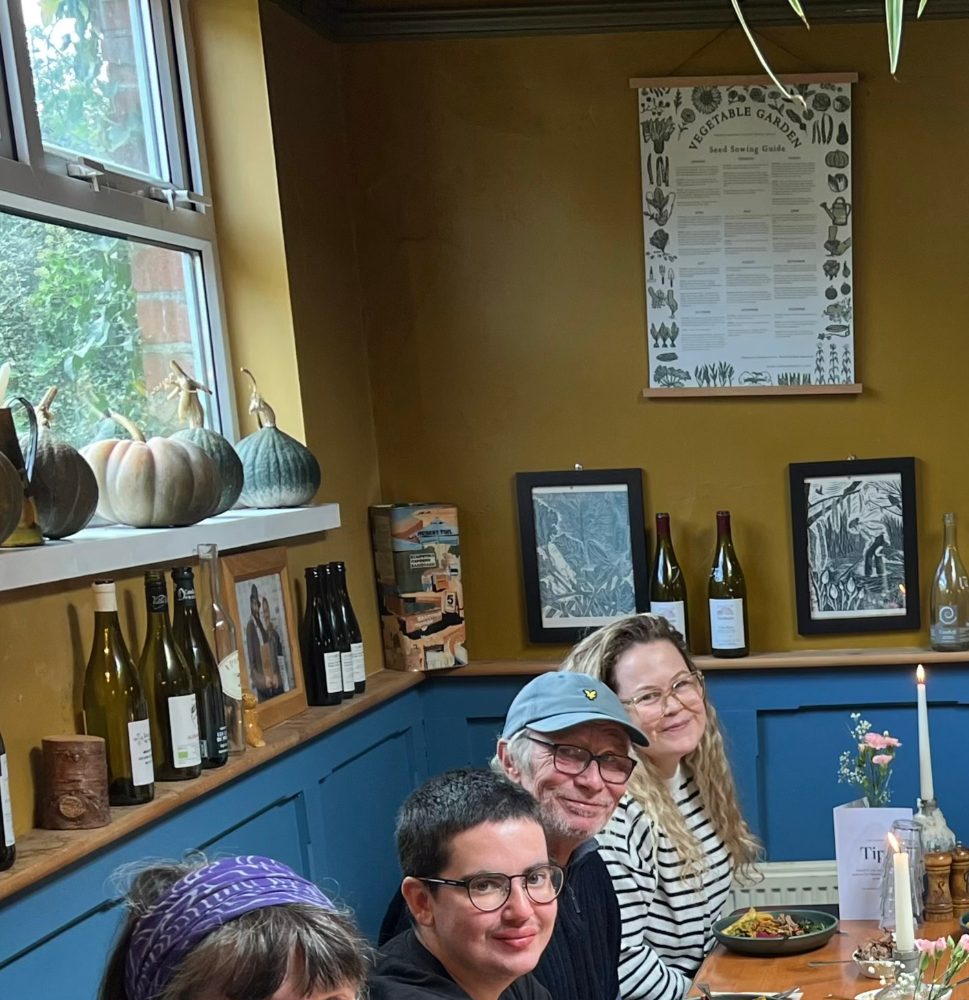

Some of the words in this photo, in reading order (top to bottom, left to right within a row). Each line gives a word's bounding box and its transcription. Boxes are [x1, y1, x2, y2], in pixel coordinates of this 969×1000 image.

[689, 107, 751, 150] VEGETABLE
[756, 108, 802, 148] GARDEN
[709, 145, 728, 153] Seed
[730, 145, 759, 154] Sowing
[762, 144, 786, 153] Guide
[447, 594, 454, 605] 5
